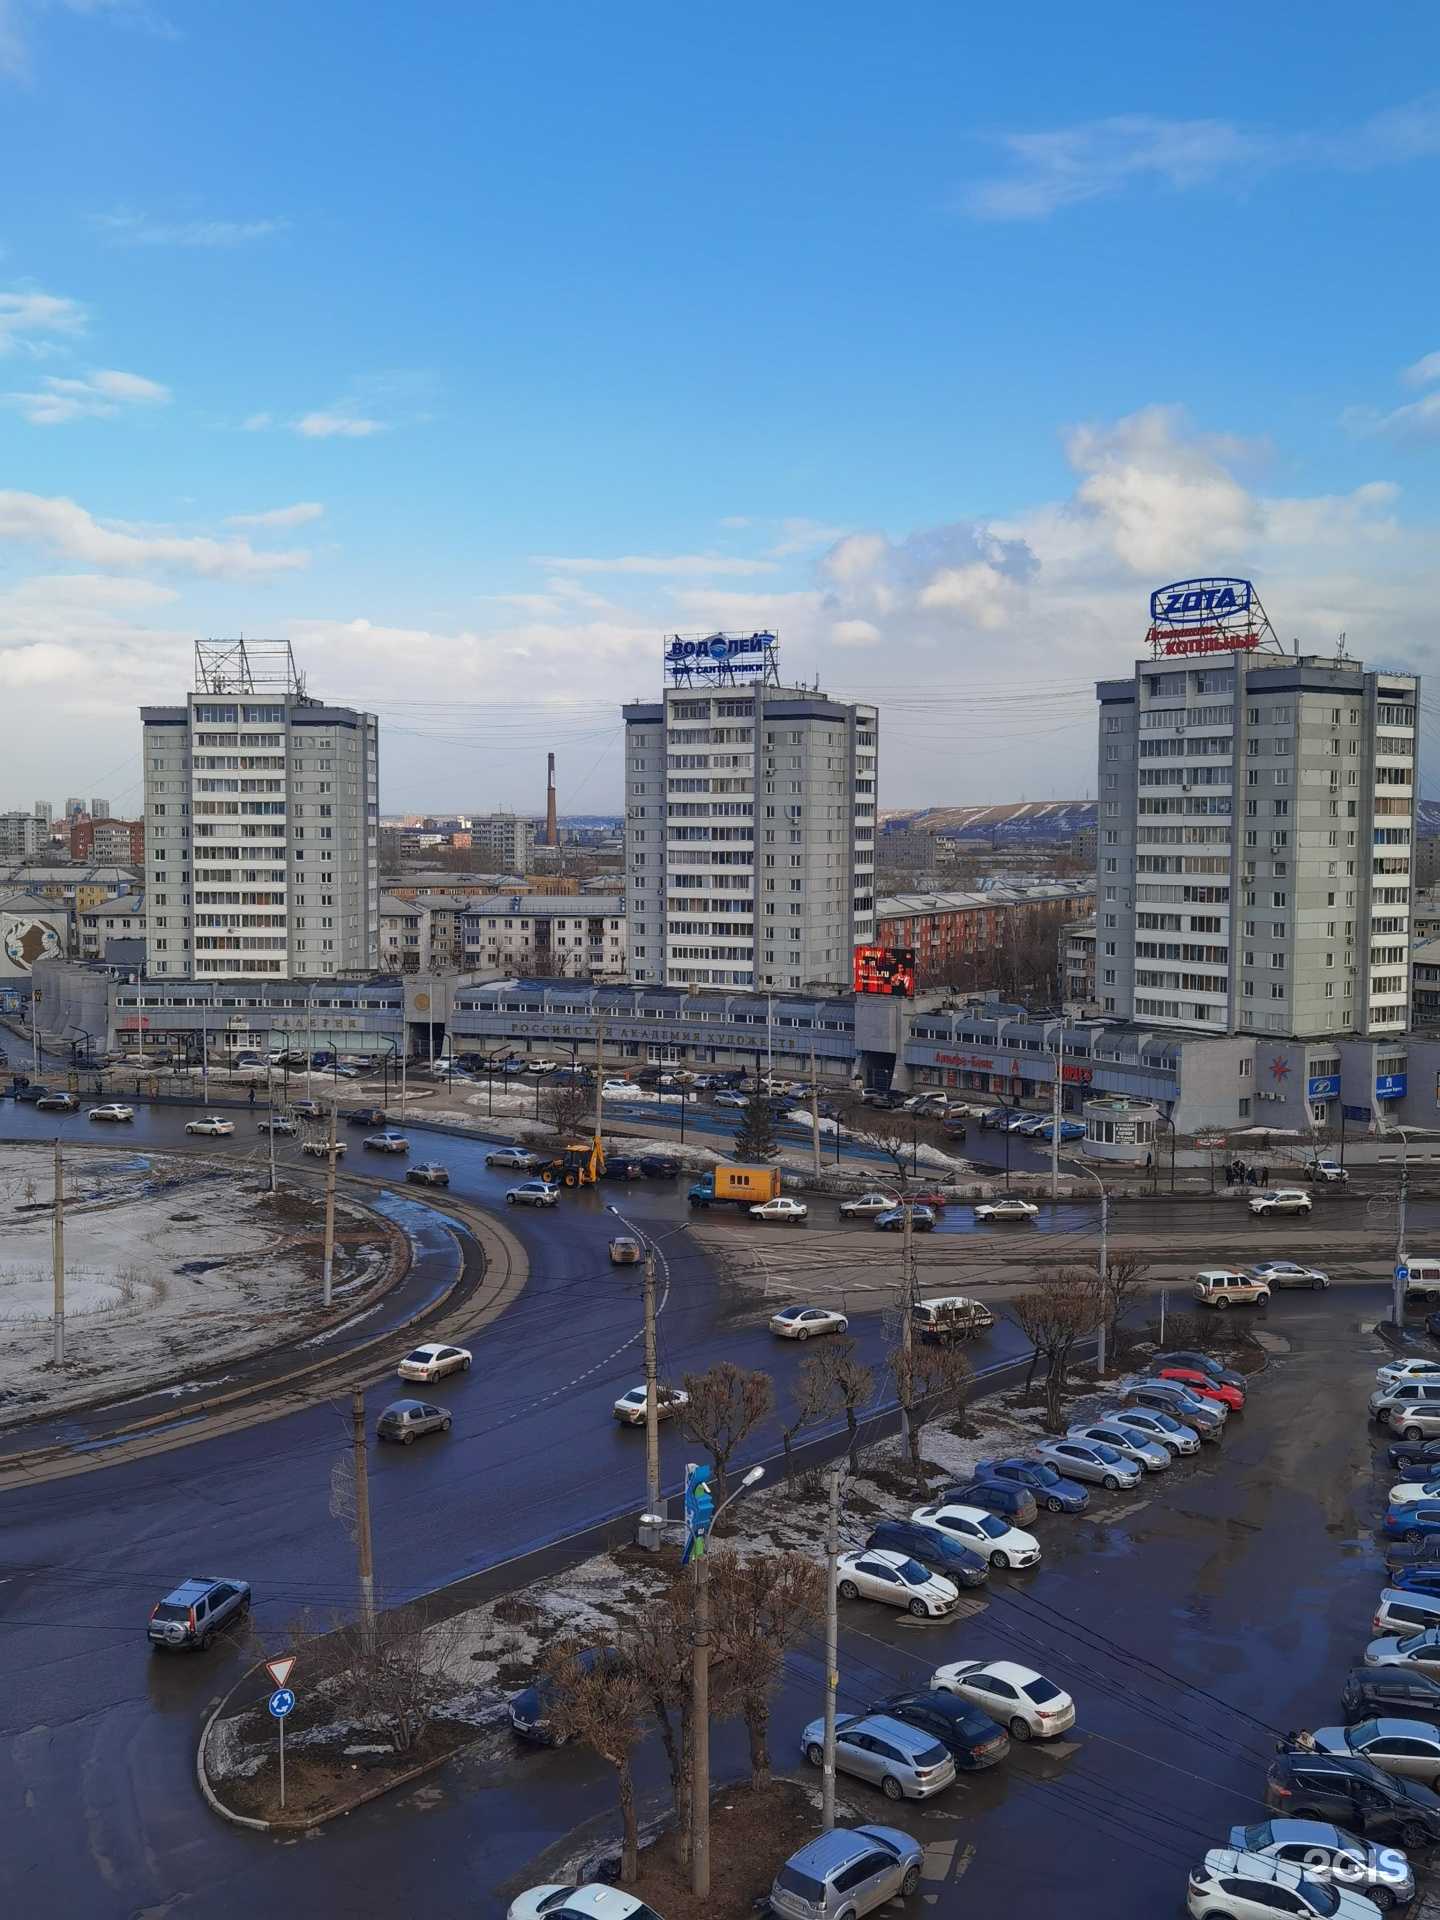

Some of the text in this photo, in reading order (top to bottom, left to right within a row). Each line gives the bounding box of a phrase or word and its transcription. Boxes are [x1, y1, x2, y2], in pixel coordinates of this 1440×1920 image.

[1165, 588, 1236, 614] ZOTA
[511, 1023, 612, 1036] РОССИЙСКАЯ
[620, 1028, 700, 1042] АКАДЕМИЯ
